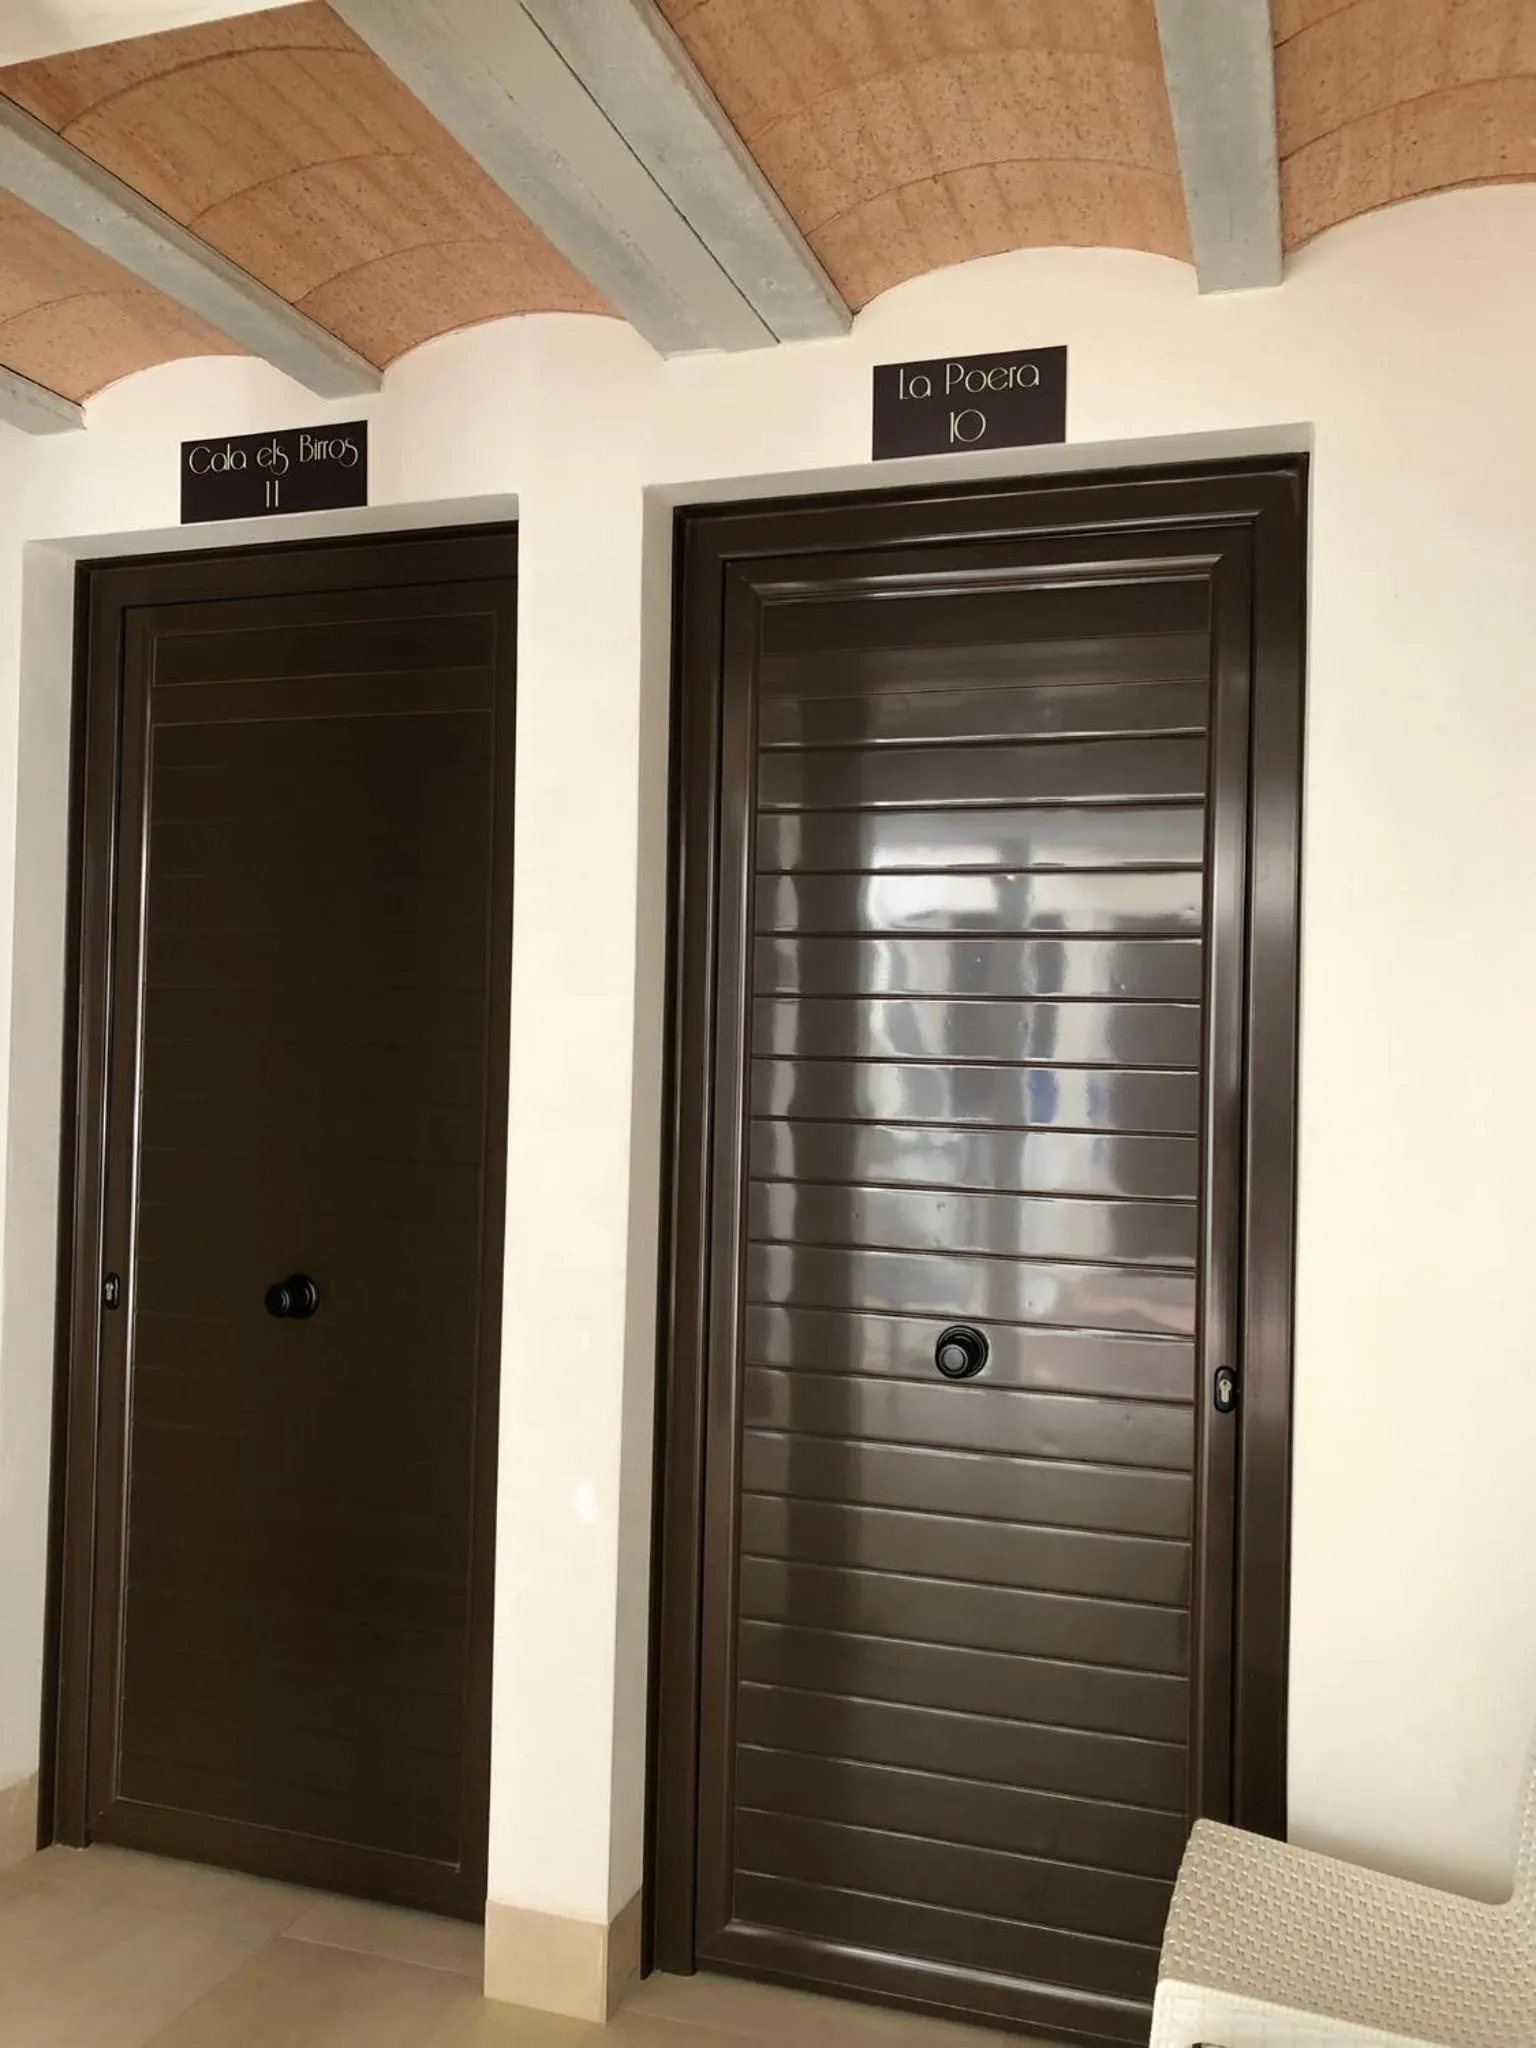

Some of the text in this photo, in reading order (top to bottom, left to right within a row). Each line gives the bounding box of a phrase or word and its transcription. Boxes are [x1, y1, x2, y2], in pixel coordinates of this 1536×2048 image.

[899, 362, 1040, 400] La Poera
[949, 408, 987, 444] 10
[189, 434, 359, 476] Cala els Birros
[265, 480, 280, 508] 11
